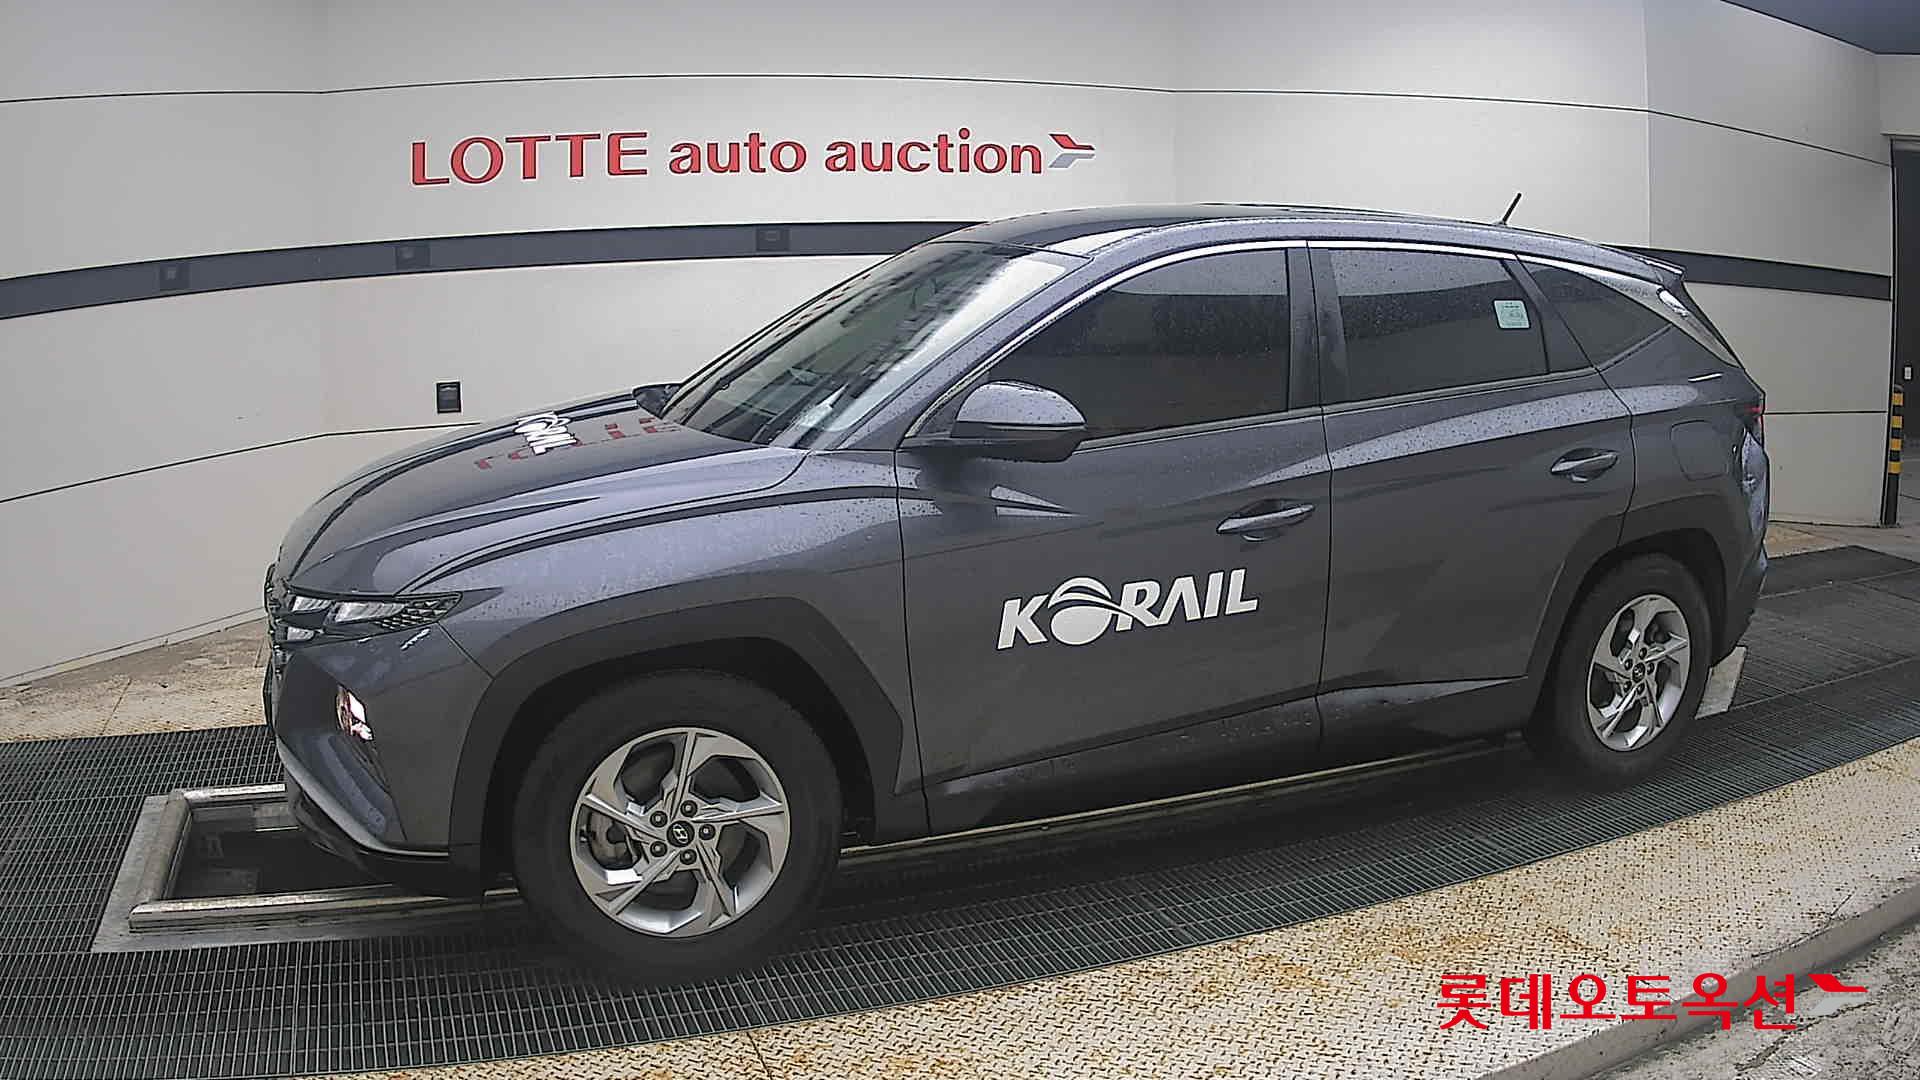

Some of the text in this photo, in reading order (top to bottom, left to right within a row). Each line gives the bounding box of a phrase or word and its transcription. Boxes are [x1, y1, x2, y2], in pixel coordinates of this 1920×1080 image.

[412, 127, 1042, 186] LOTTE auto auction
[997, 567, 1260, 650] KORAIL
